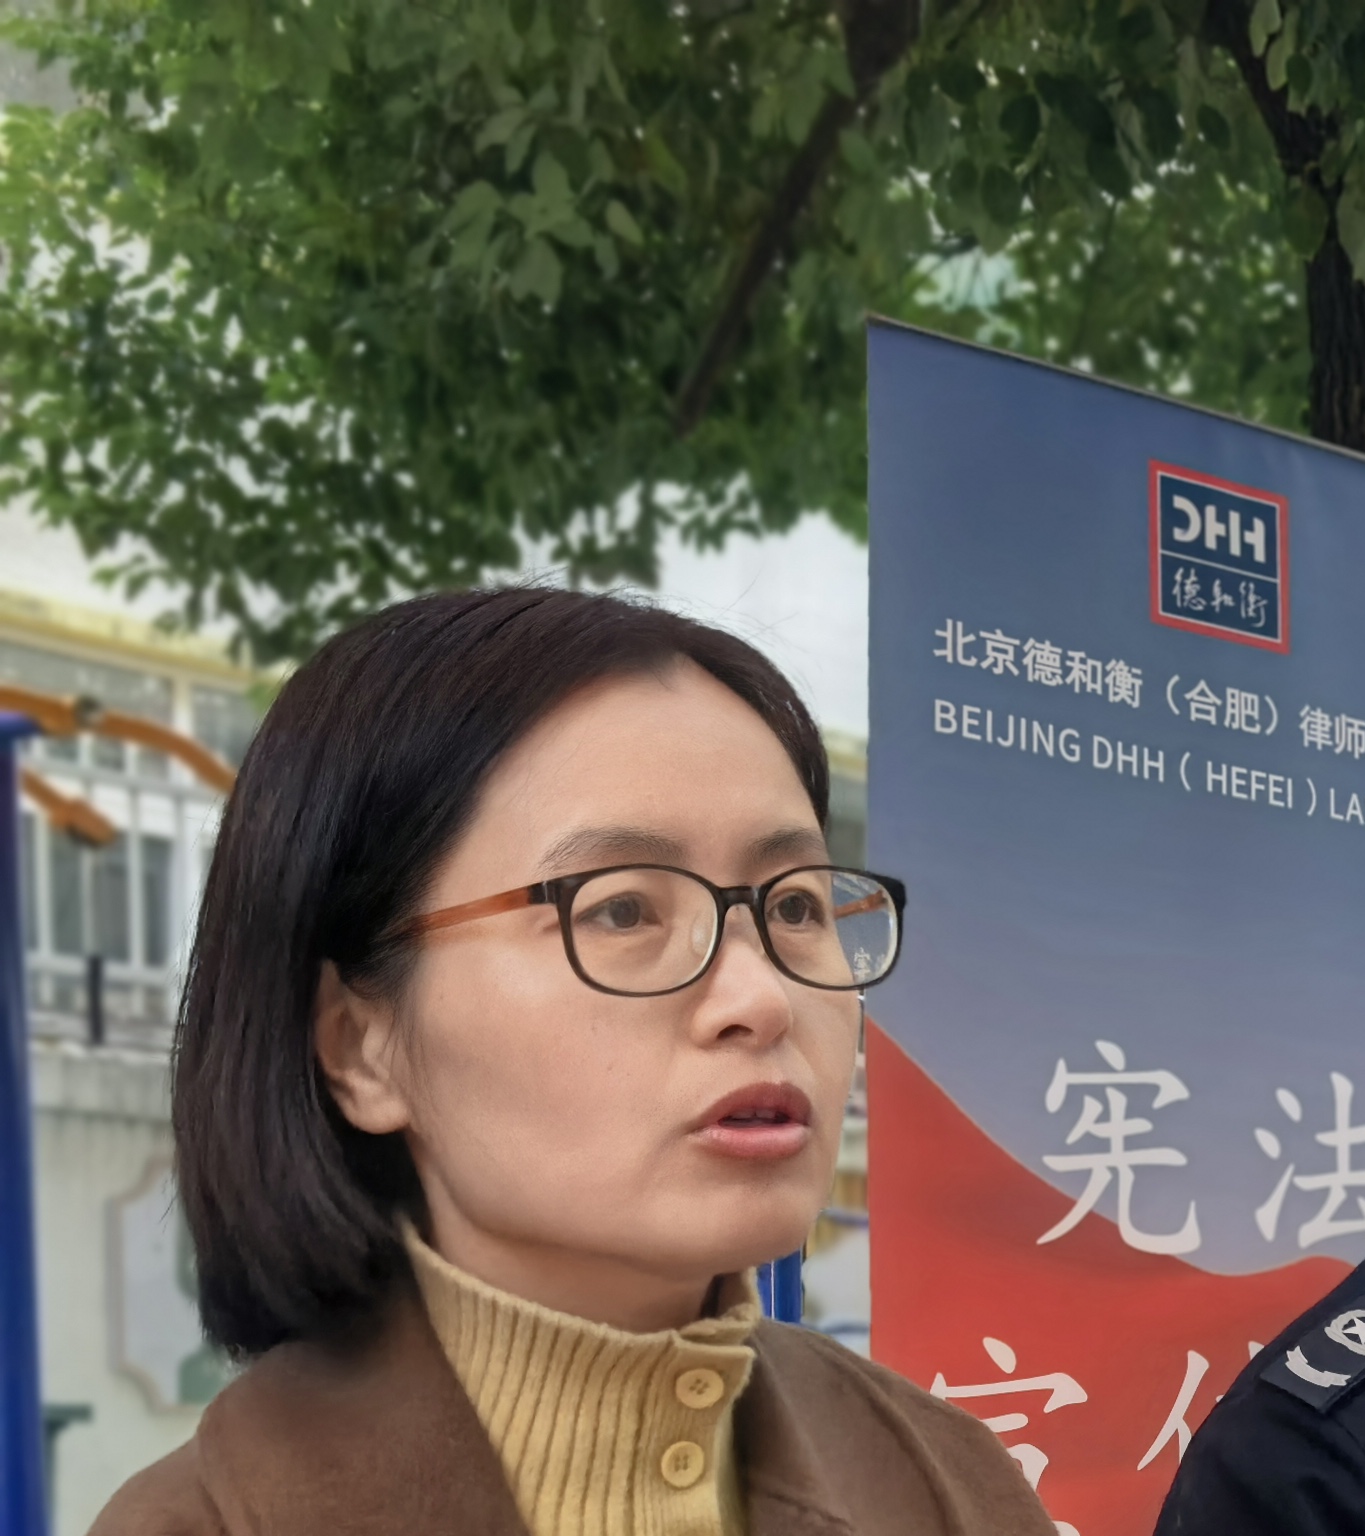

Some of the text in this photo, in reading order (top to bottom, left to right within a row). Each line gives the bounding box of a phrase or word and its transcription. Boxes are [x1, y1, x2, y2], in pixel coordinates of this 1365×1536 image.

[1172, 494, 1267, 564] DHH
[1172, 566, 1269, 628] 德和衡
[933, 698, 1081, 764] BEIJING
[1091, 738, 1166, 783] DHH
